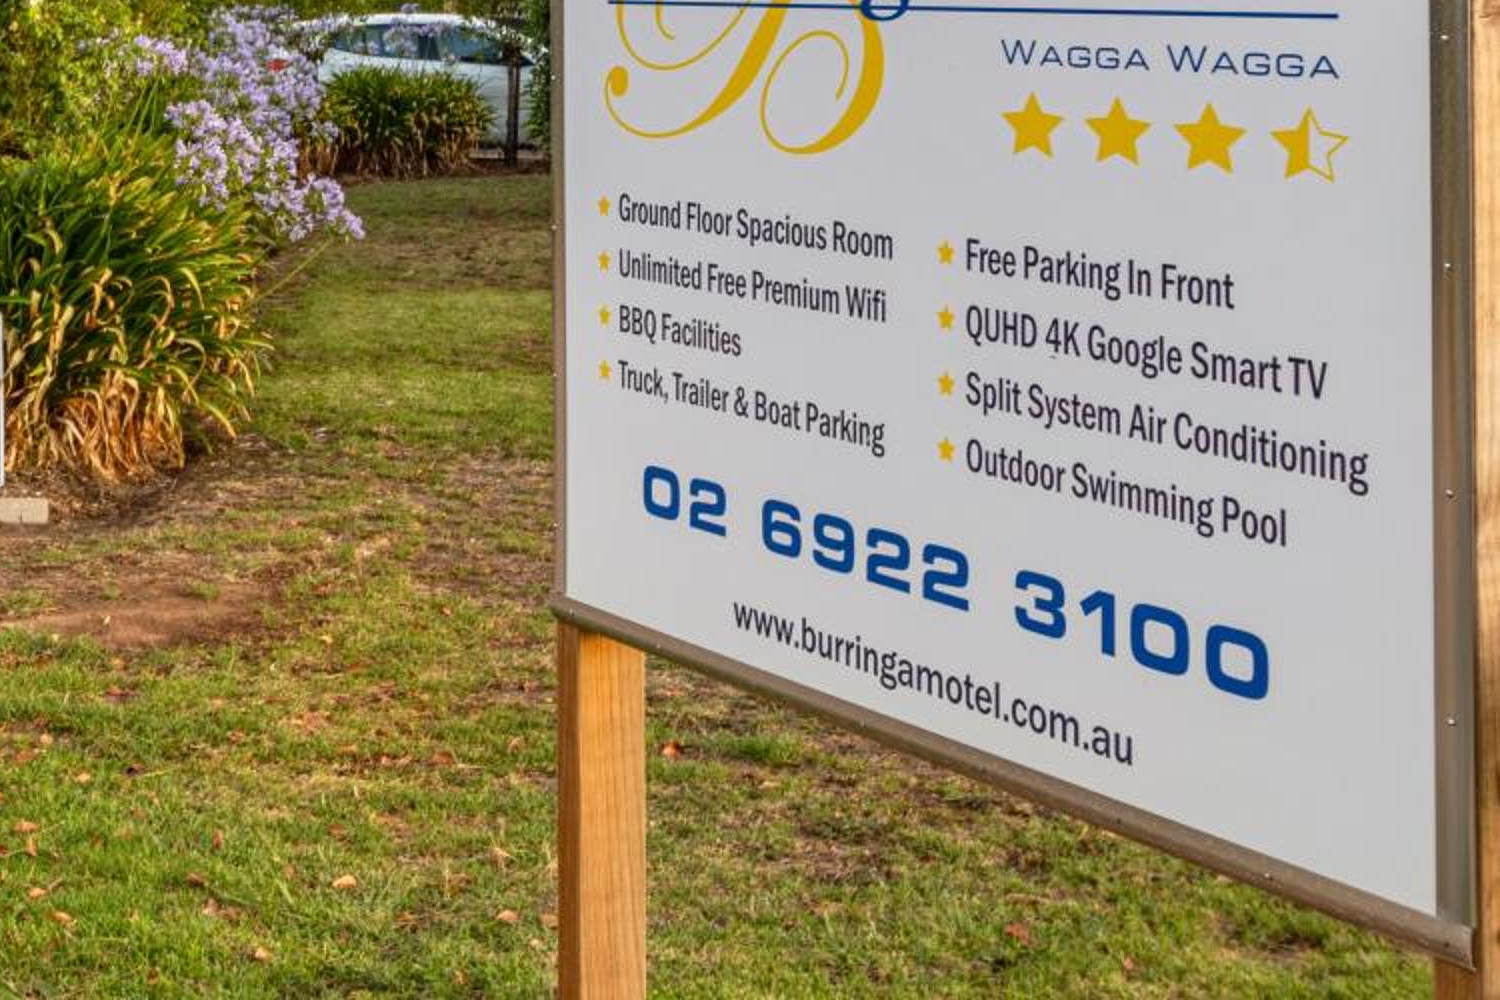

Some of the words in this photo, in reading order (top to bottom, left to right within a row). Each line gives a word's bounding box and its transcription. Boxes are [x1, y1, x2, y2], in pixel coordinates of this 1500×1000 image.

[618, 192, 681, 230] Ground
[686, 201, 733, 237] Floor
[736, 207, 827, 251] Spacious
[832, 220, 893, 261] Room
[966, 237, 1017, 278] Free
[1023, 245, 1121, 302] Parking
[1127, 257, 1158, 297] In
[1161, 263, 1235, 310] Front
[619, 248, 702, 291] Unlimited
[707, 263, 747, 299] Free
[751, 269, 840, 315] Premium
[845, 284, 886, 323] Wifi
[619, 304, 657, 345] BBQ
[661, 312, 742, 357] Facilities
[965, 304, 1038, 349] QUHD
[1044, 317, 1081, 358] 4K
[1087, 324, 1183, 380] Google
[1190, 340, 1283, 393] Smart
[1287, 356, 1328, 400] TV
[617, 359, 669, 401] Truck,
[672, 371, 730, 413] Trailer
[733, 386, 749, 419] &
[754, 390, 801, 431] Boat
[805, 401, 885, 458] Parking
[965, 371, 1023, 417] Split
[1027, 383, 1121, 436] System
[1128, 403, 1168, 445] Air
[1171, 411, 1369, 497] Conditioning
[965, 438, 1066, 493] Outdoor
[1071, 461, 1215, 539] Swimming
[1222, 495, 1287, 547] Pool
[642, 465, 727, 537] 02
[761, 498, 970, 613] 6922
[1014, 569, 1270, 701] 3100
[733, 602, 1134, 766] www.burringamotel.com.au
